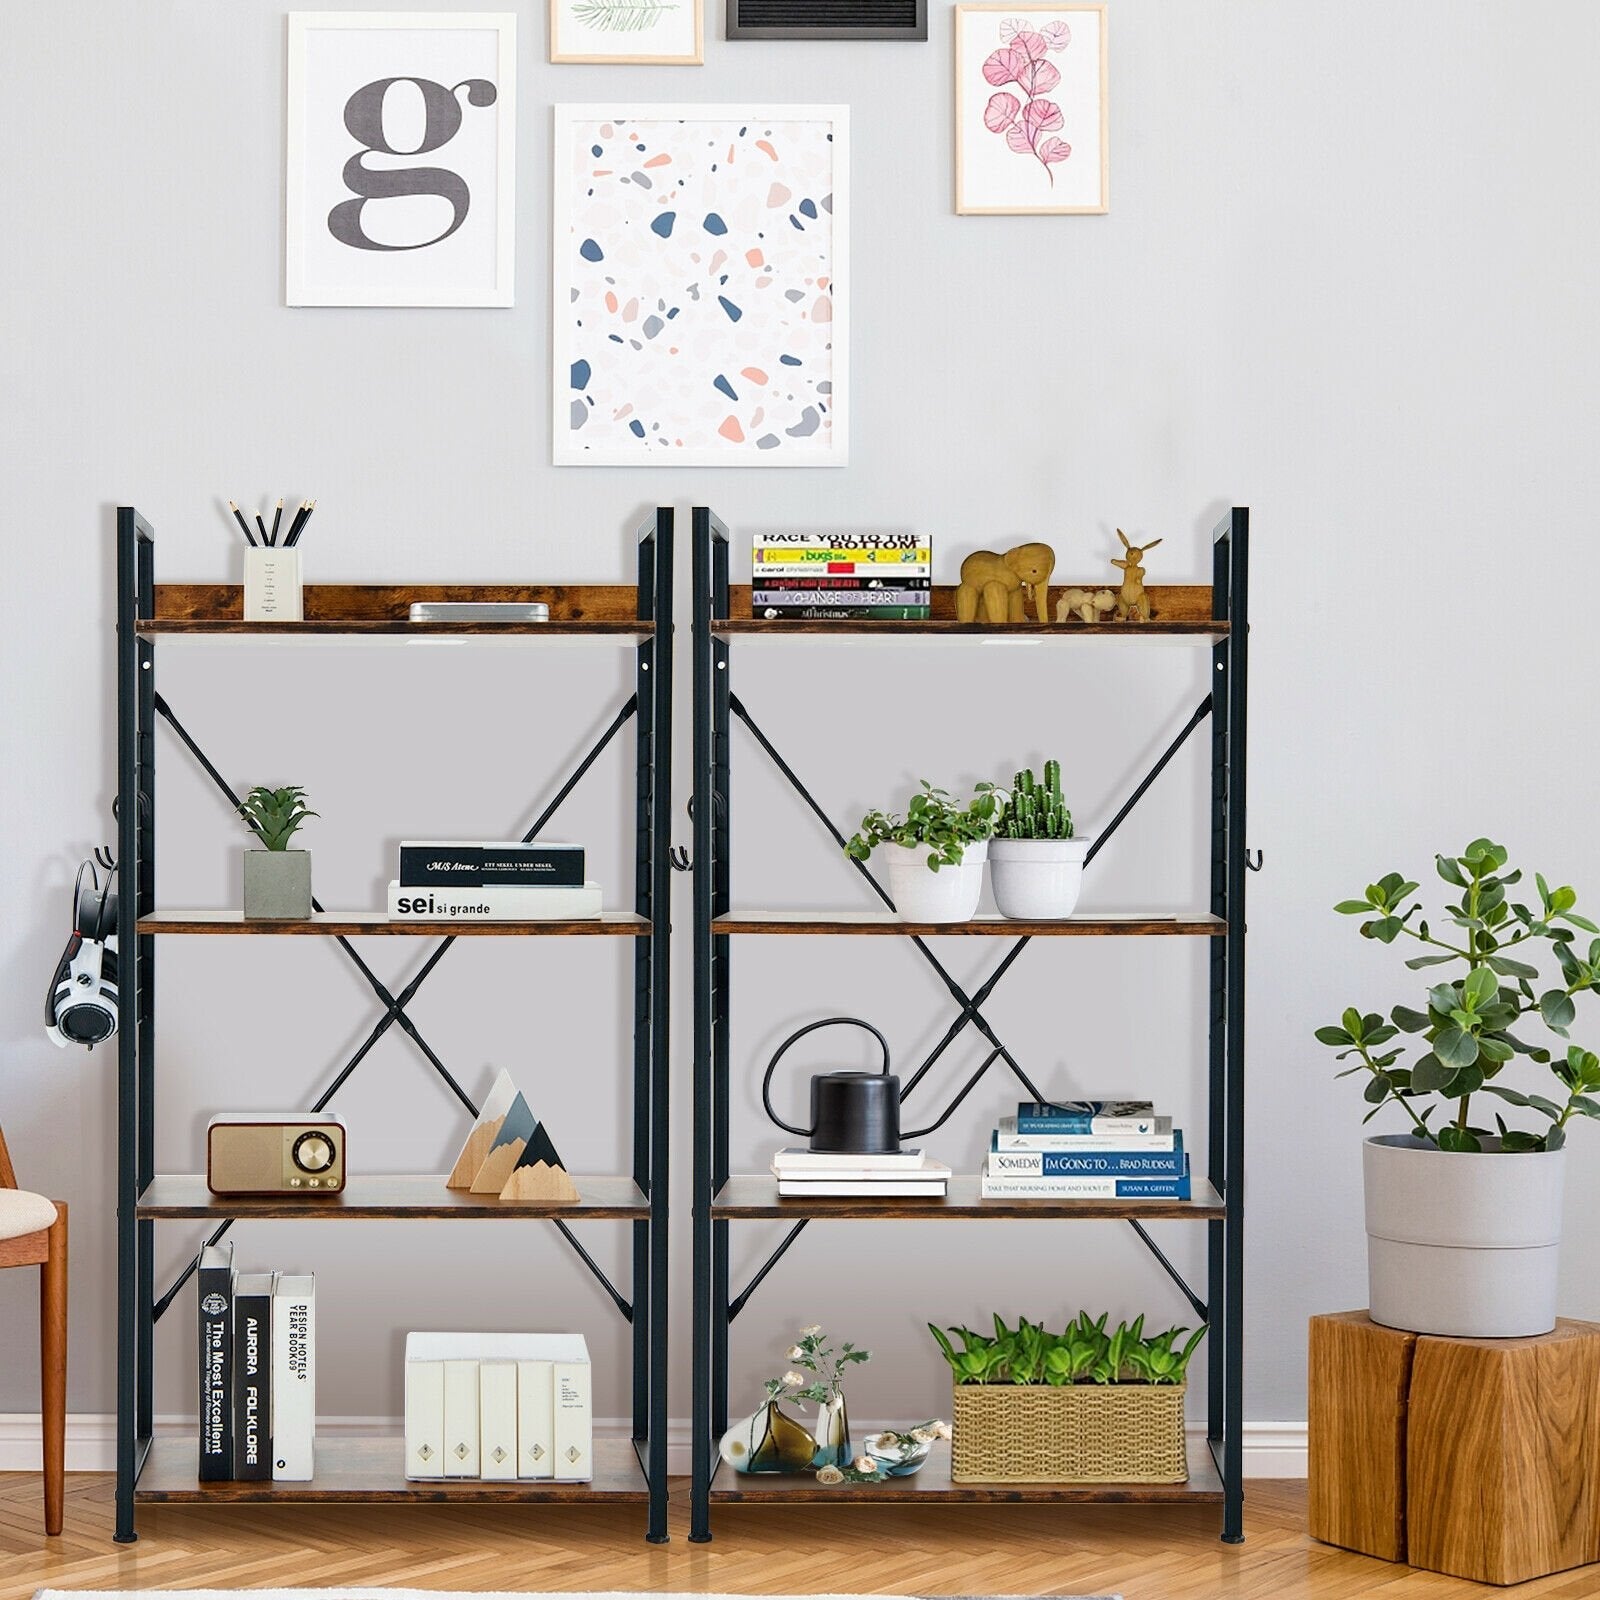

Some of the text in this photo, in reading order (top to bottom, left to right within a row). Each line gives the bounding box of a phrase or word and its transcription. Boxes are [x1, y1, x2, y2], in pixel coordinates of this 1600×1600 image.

[327, 76, 498, 252] g
[762, 534, 921, 542] RACE YOU TO THE
[829, 540, 917, 549] BOTTOM
[793, 591, 841, 604] CHANGE
[862, 591, 900, 603] HEART
[397, 893, 491, 916] sei si grande
[998, 1157, 1042, 1169] SOMEDAY
[1060, 1156, 1093, 1169] GOING
[1120, 1159, 1141, 1169] BRAD
[289, 1304, 298, 1330] YEAR
[297, 1304, 307, 1380] DESIGN HOTELS
[211, 1321, 225, 1455] The Most Excellent
[246, 1317, 258, 1465] AURORA FOLKLORE
